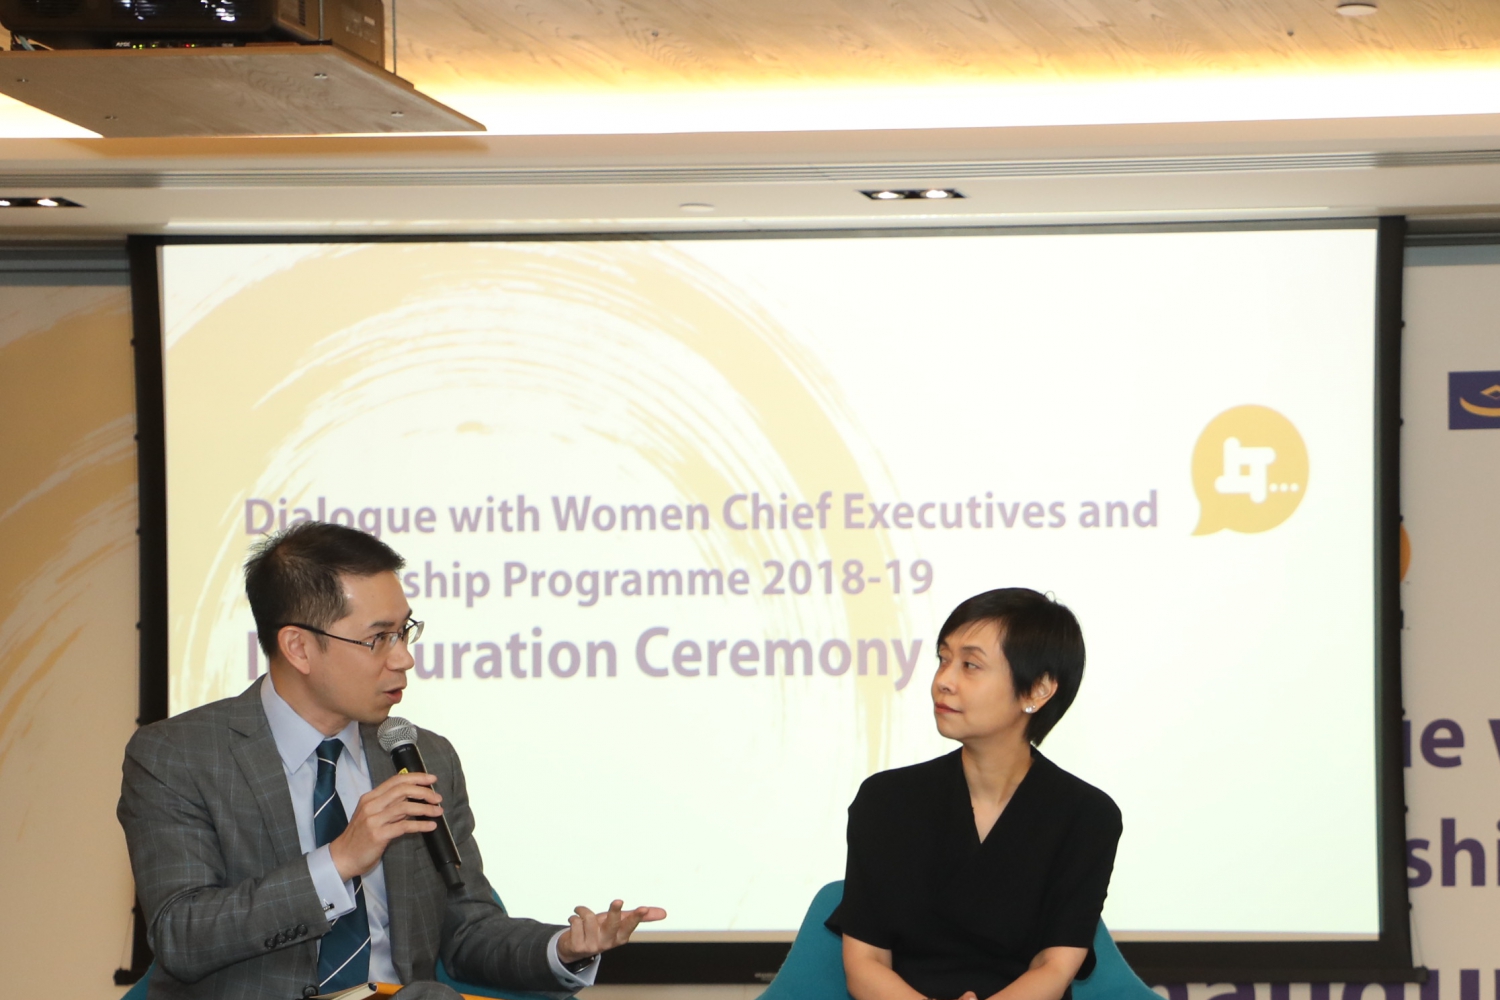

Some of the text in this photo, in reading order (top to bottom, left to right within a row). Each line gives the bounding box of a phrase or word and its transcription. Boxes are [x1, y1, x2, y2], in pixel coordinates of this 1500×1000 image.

[449, 494, 541, 533] with
[550, 494, 710, 533] Women
[722, 490, 832, 531] Chief
[843, 490, 1067, 530] Executives
[1079, 489, 1158, 529] and
[504, 560, 750, 607] Programme
[762, 557, 934, 597] 2018-19
[247, 626, 924, 692] Iuration Ceremony
